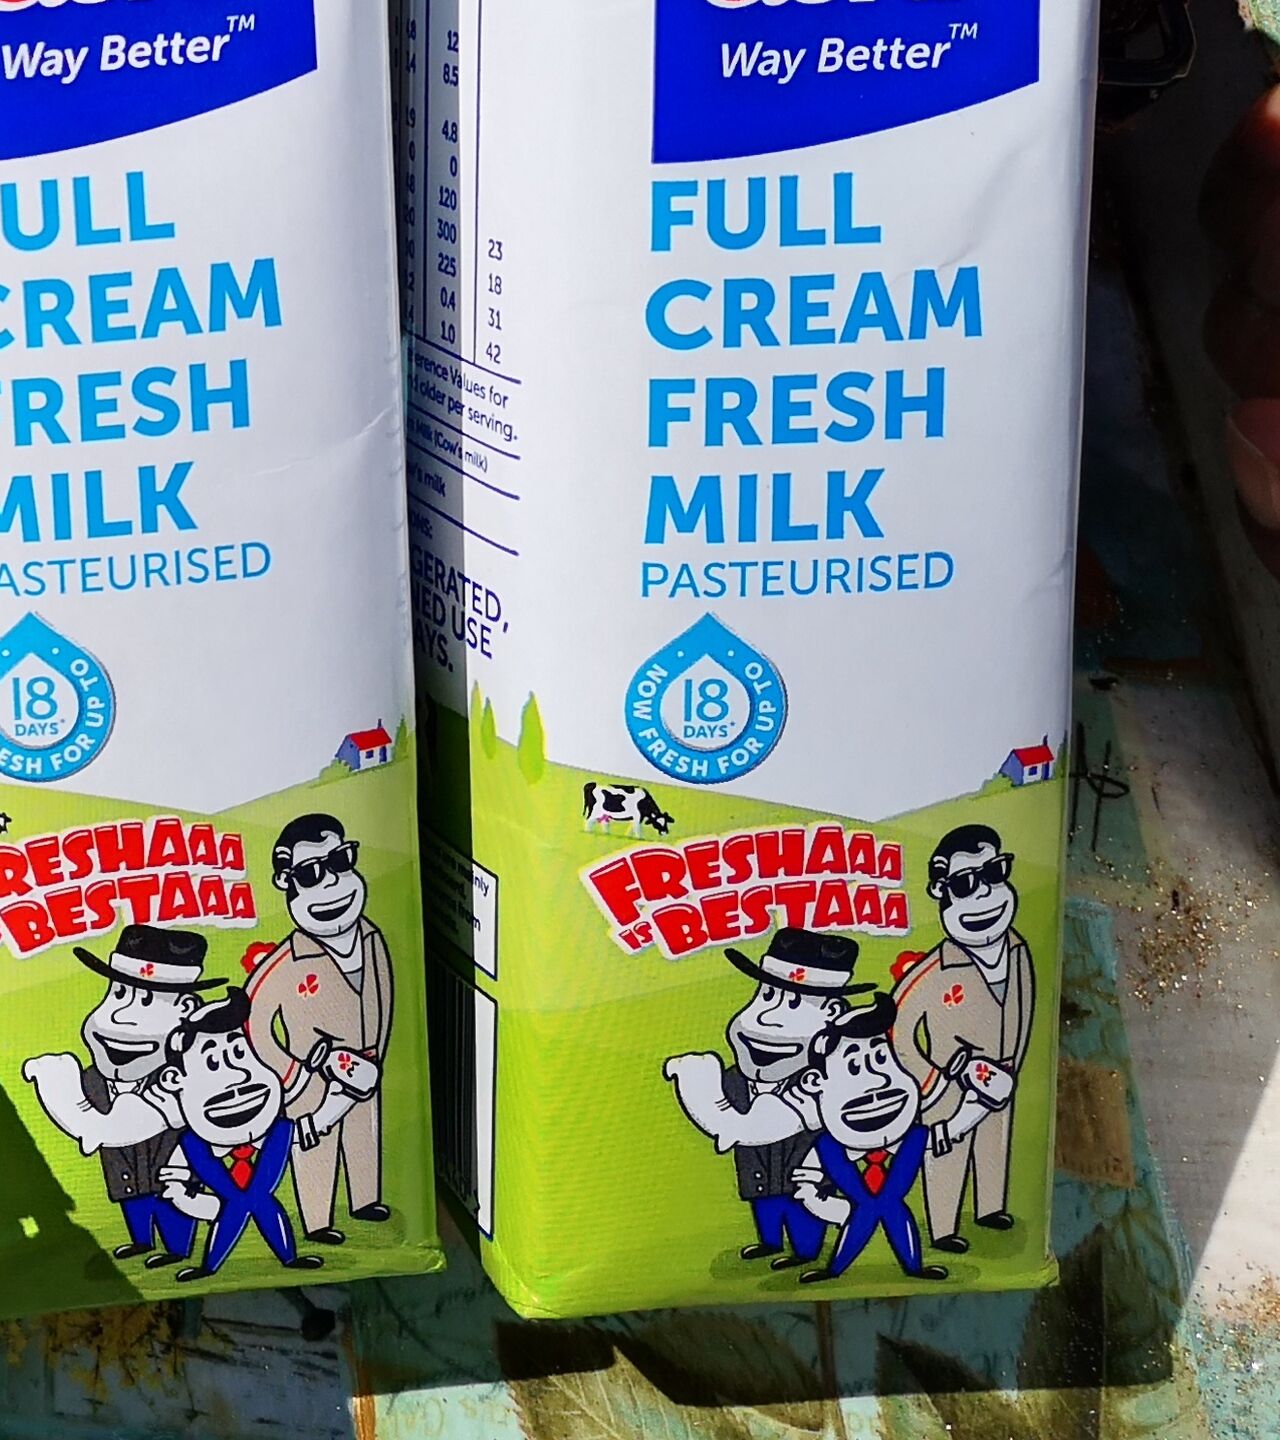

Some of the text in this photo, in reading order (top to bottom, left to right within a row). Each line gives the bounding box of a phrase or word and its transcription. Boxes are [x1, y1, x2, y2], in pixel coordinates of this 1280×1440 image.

[0, 37, 90, 85] Way
[99, 28, 230, 72] Better
[447, 29, 459, 53] 12
[720, 41, 806, 84] Way
[816, 35, 950, 76] Better
[443, 64, 460, 88] 8.5
[441, 119, 458, 144] 4.8
[450, 156, 458, 177] 0
[439, 185, 457, 211] 120
[651, 171, 882, 252] FULL
[437, 218, 456, 245] 300
[488, 239, 503, 261] 23
[438, 253, 456, 277] 225
[488, 273, 502, 295] 18
[440, 286, 456, 311] 0.4
[645, 266, 982, 350] CREAM
[488, 307, 502, 331] 31
[485, 341, 501, 365] 42
[450, 365, 509, 409] Values for
[648, 366, 945, 448] FRESH
[420, 381, 518, 442] older per serving.
[434, 429, 488, 473] (Cow's milk)
[424, 470, 447, 497] milk
[643, 468, 885, 545] MILK
[411, 543, 509, 633] GERATED,
[641, 551, 954, 598] PASTEURISED
[452, 605, 492, 659] USE
[69, 658, 101, 694] TO
[12, 677, 56, 721] 18
[85, 696, 105, 729] UP
[683, 678, 729, 722] 18
[632, 661, 778, 778] NOW FRESH FOR UP TO
[52, 732, 96, 772] FOR
